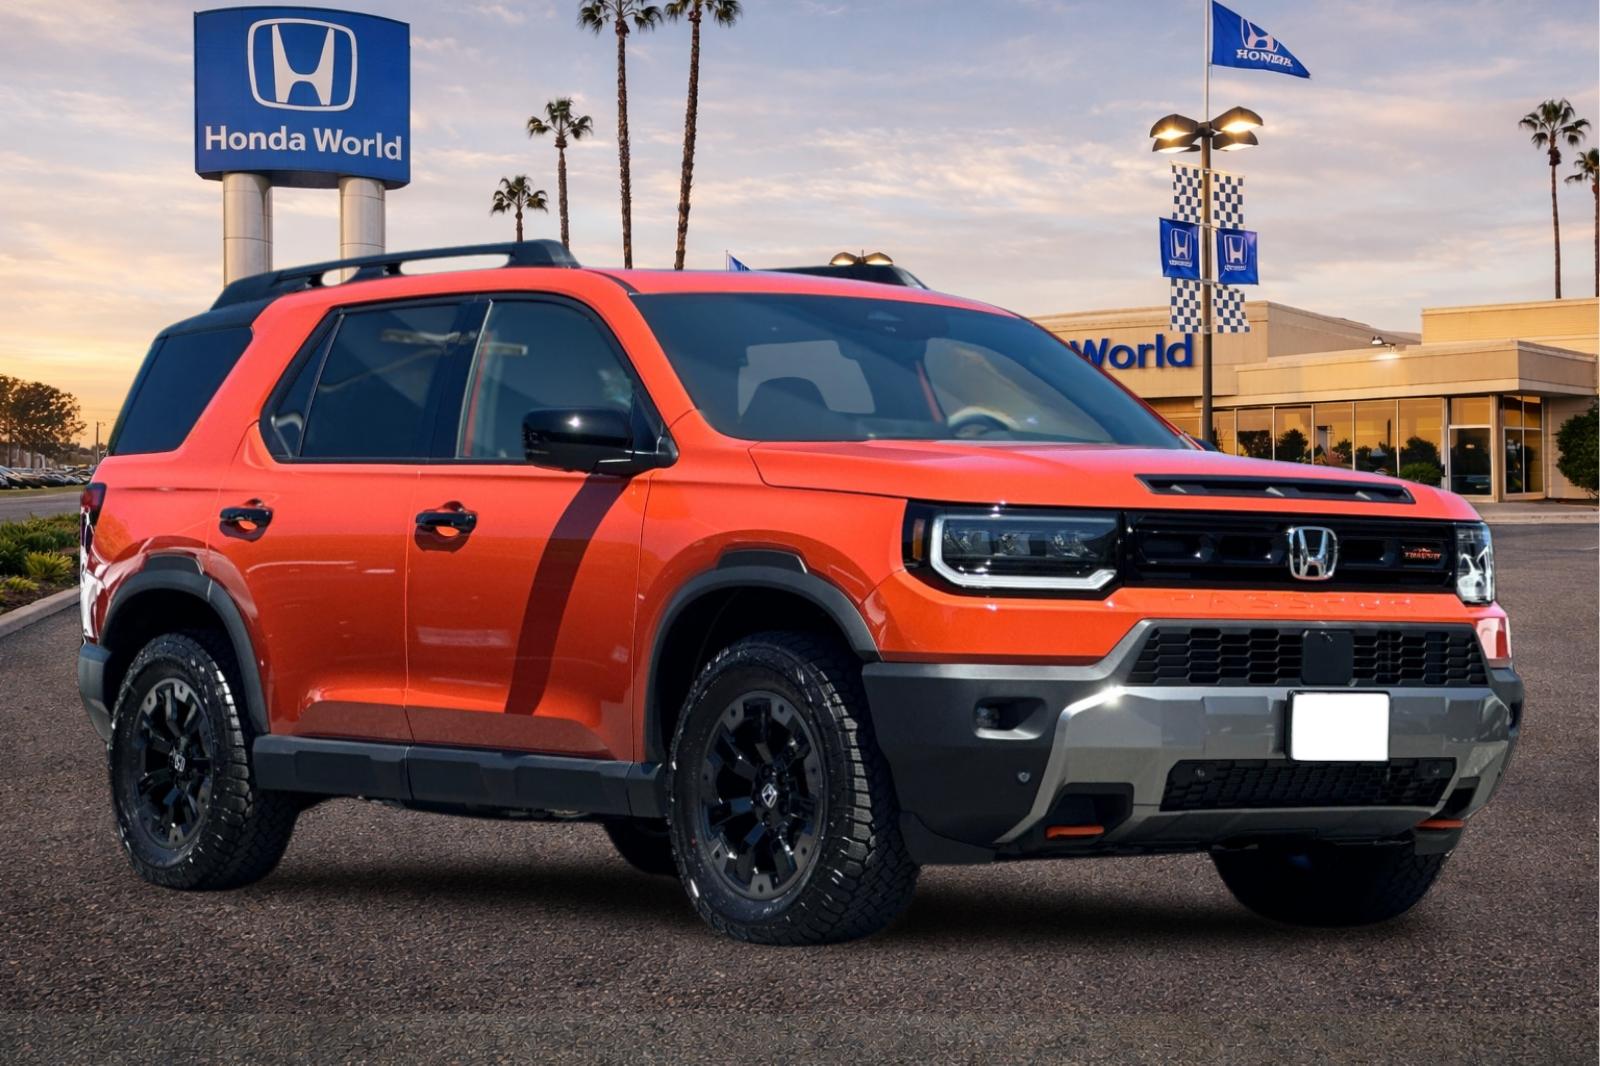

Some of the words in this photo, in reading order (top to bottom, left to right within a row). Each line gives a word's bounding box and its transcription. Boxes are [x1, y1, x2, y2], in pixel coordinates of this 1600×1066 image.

[205, 125, 306, 151] Honda
[312, 127, 402, 161] World
[1069, 333, 1194, 370] World
